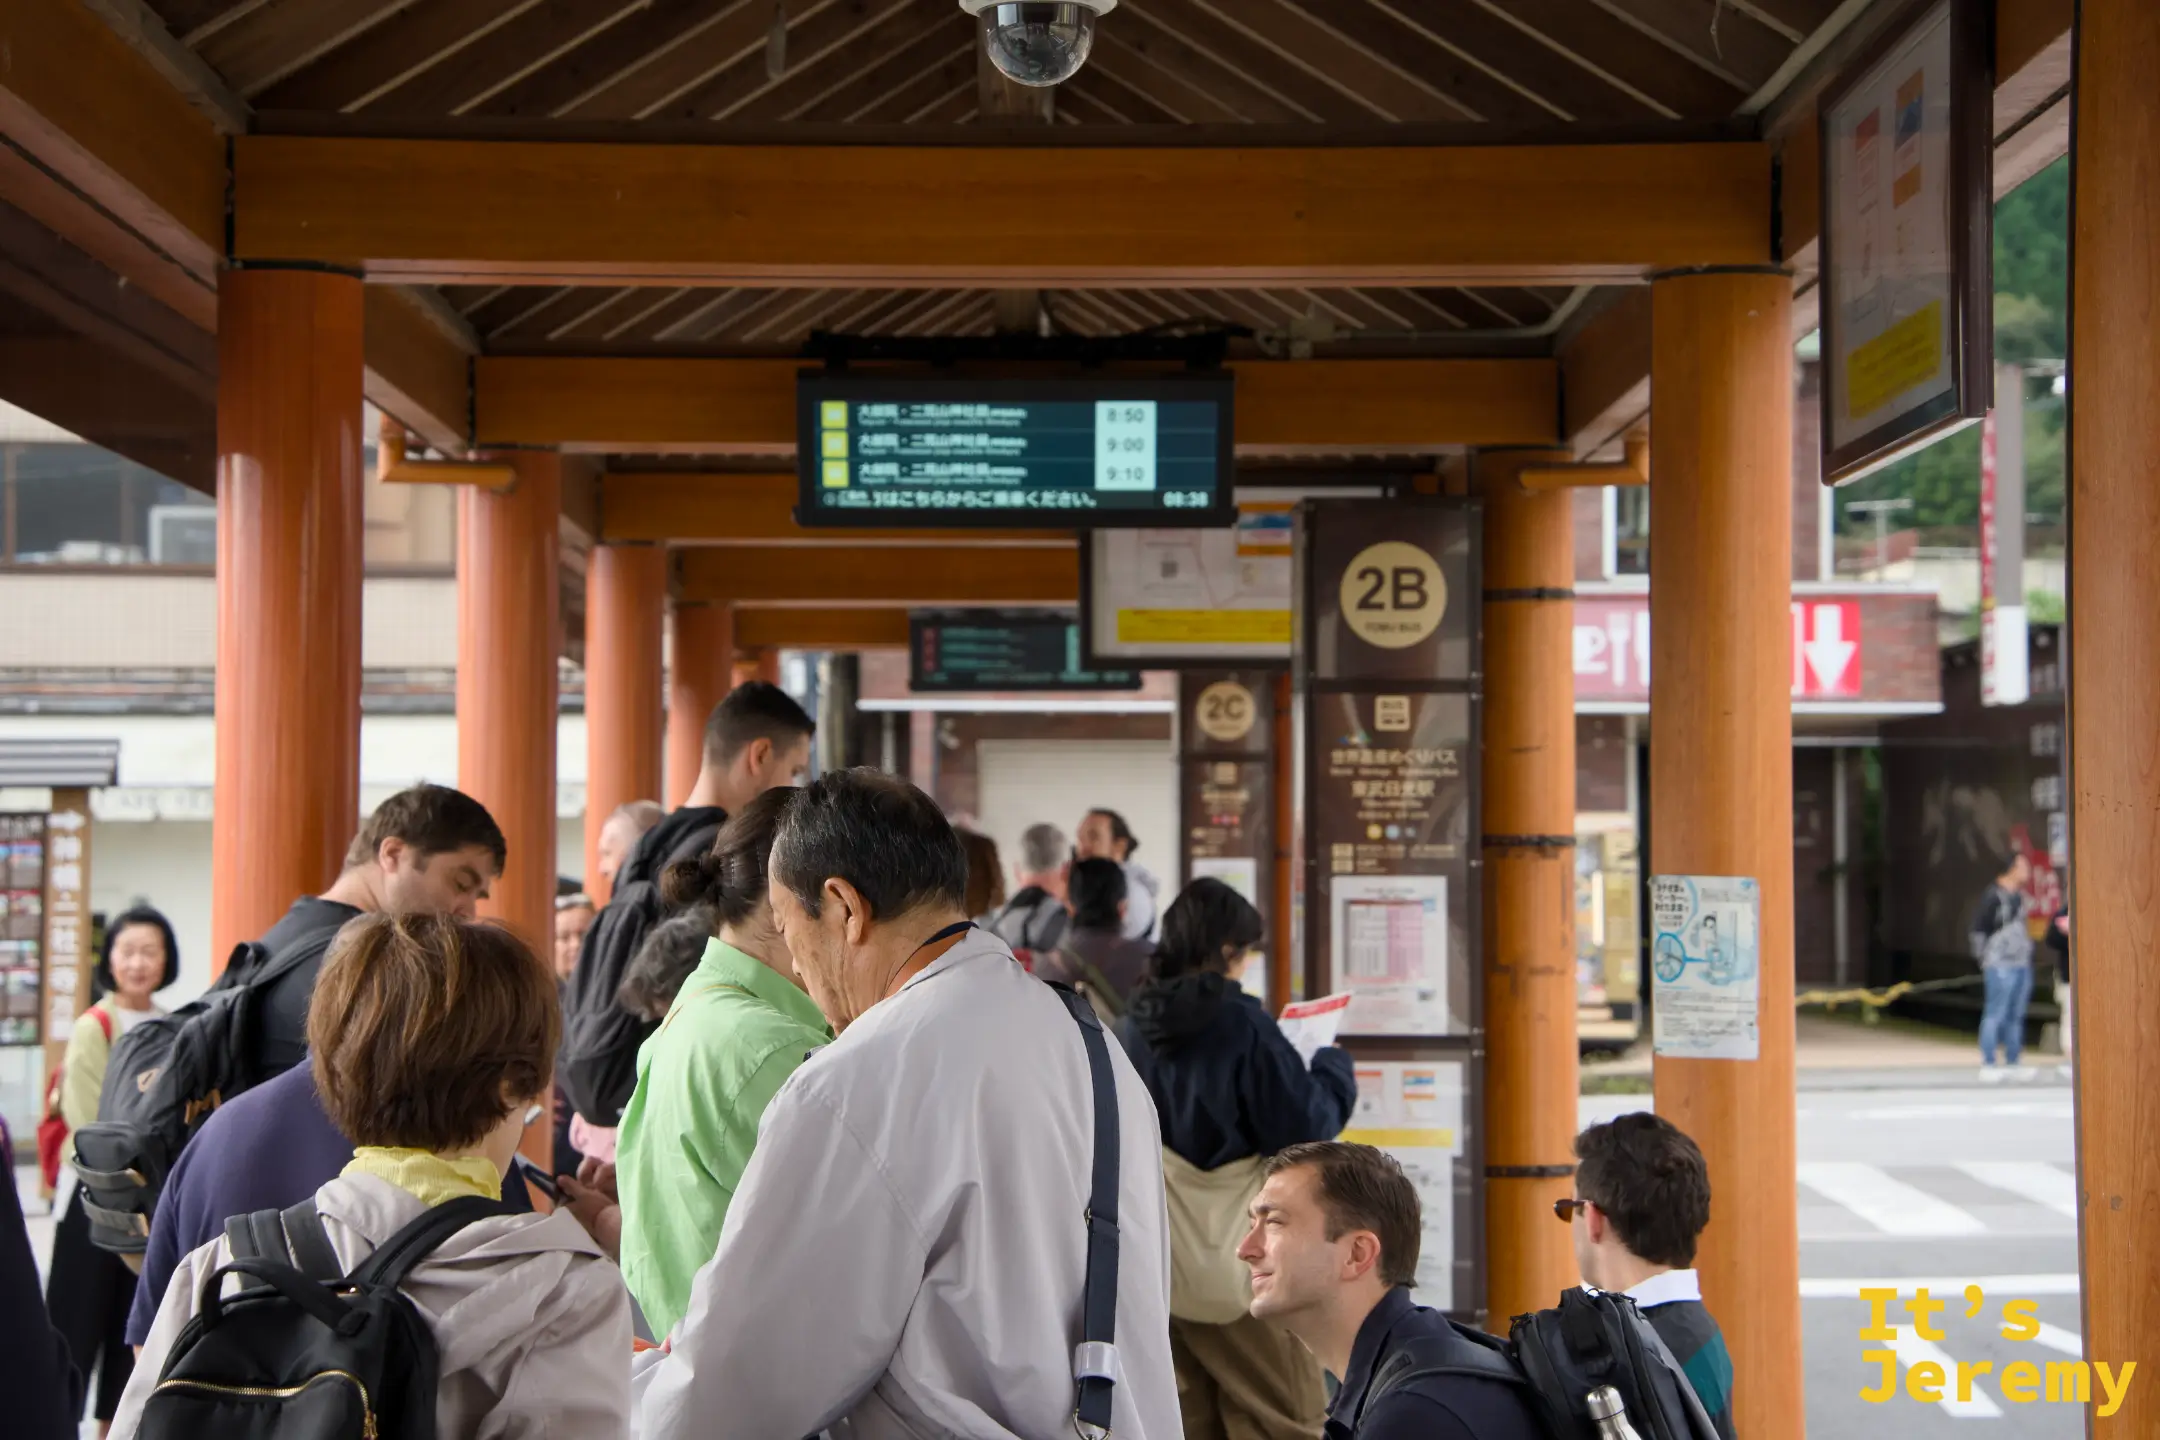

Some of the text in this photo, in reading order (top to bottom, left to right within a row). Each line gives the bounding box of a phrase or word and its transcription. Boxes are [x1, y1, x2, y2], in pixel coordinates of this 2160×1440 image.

[1106, 407, 1145, 423] 8:50
[1106, 437, 1145, 453] 9:00
[1106, 466, 1145, 482] 9:10
[1356, 566, 1429, 610] 2B
[1206, 693, 1245, 720] 2C
